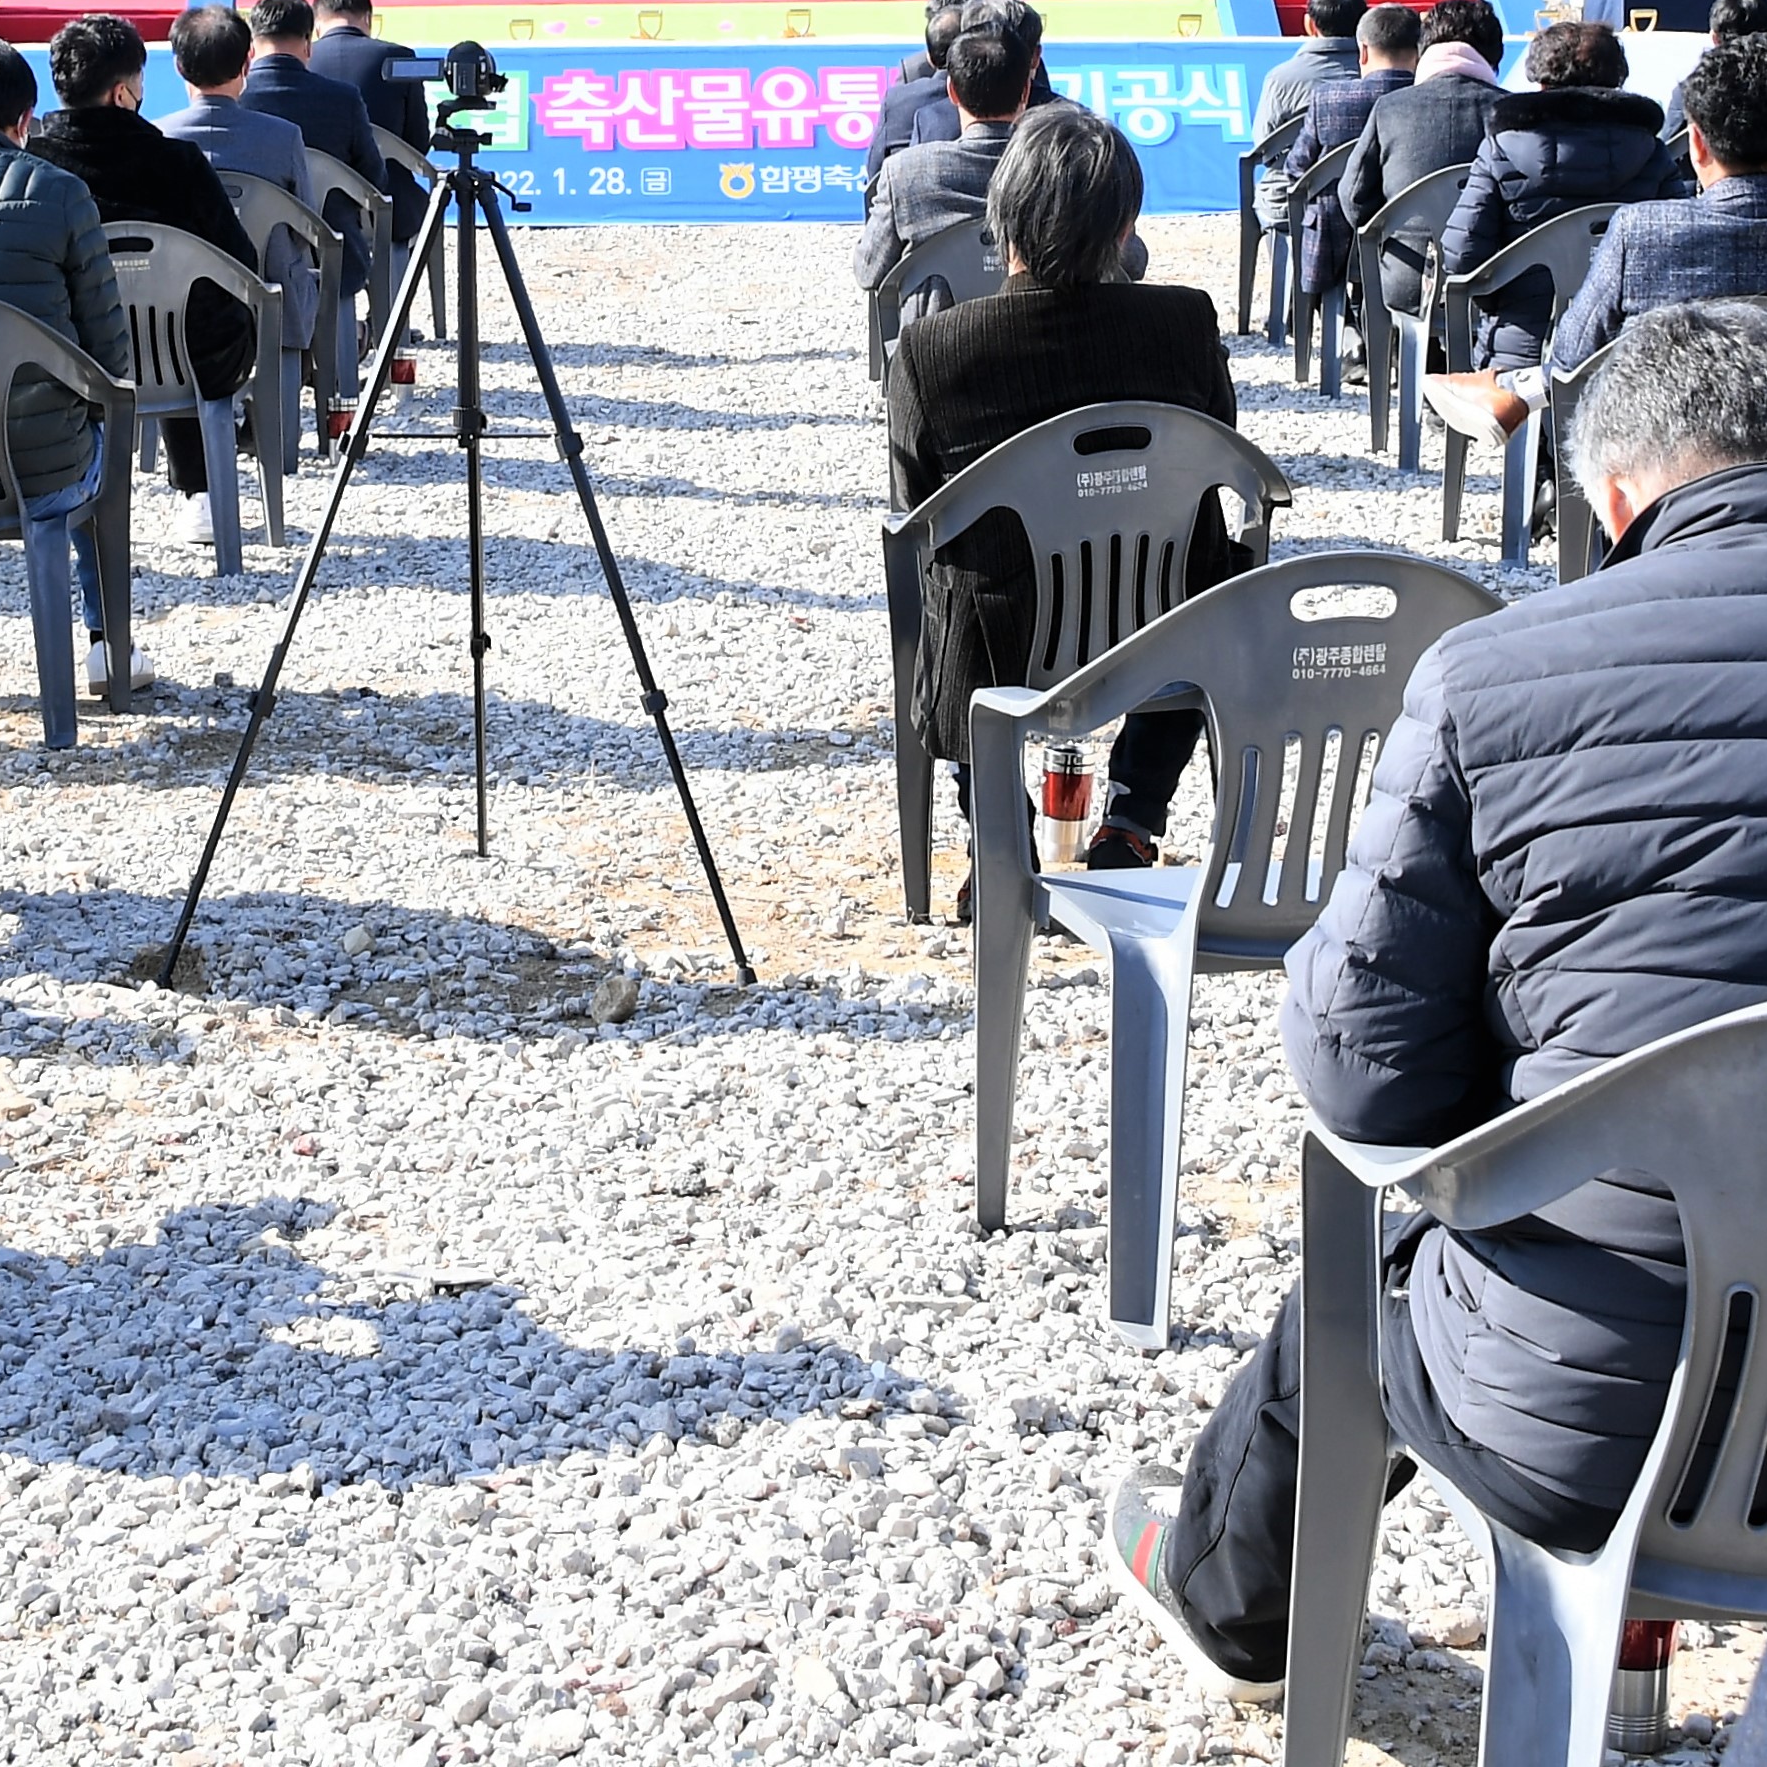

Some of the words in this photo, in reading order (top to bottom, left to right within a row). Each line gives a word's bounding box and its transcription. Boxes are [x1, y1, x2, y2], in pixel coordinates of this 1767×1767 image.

[543, 70, 881, 146] 축산물유통
[1048, 69, 1245, 140] 기공식
[493, 170, 542, 196] 22.
[552, 167, 577, 196] 1.
[588, 166, 632, 196] 28.
[1292, 643, 1386, 667] (주)광주종합렌탈
[1292, 664, 1386, 680] 010-7770-4664
